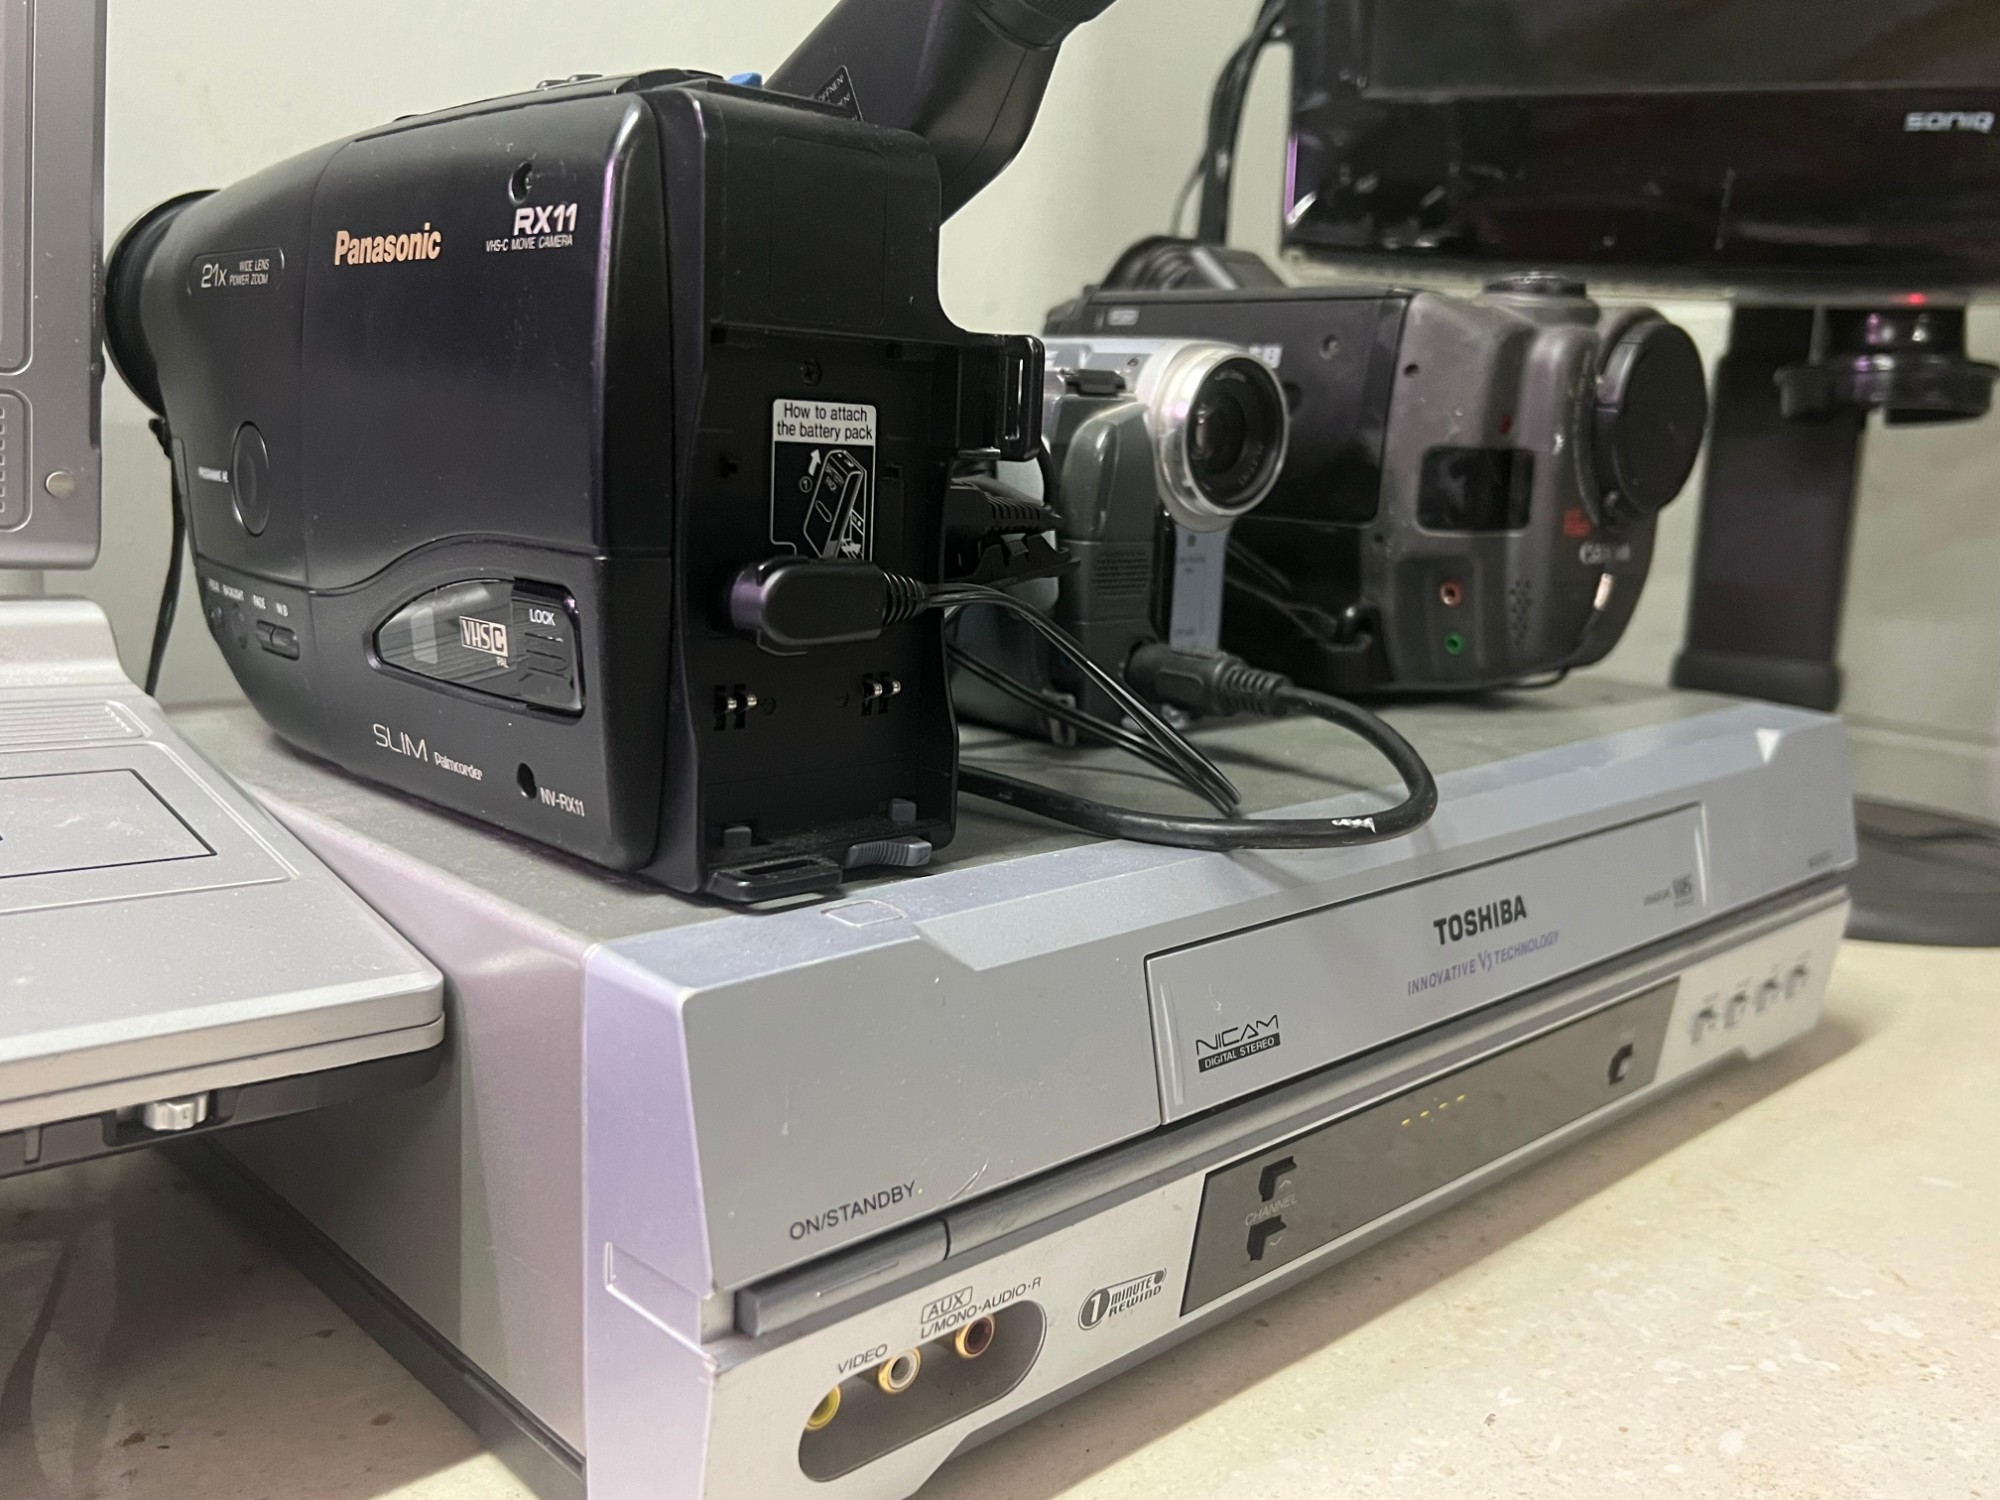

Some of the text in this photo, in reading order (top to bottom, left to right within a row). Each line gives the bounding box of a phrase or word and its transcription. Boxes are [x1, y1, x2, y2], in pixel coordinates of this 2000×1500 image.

[514, 203, 578, 236] RX11
[333, 222, 441, 266] Panasonic
[486, 233, 573, 252] VHS-C MOVIE CAMERA
[229, 273, 269, 286] POWER ZOOM
[239, 258, 270, 272] WIDE LENS
[784, 402, 867, 422] How to attach
[777, 420, 873, 441] the battery pack
[529, 608, 556, 627] LOCK
[373, 723, 483, 782] SLIM Palmcorder
[540, 786, 586, 818] NV-RX11
[1433, 894, 1528, 946] TOSHIBA
[1407, 959, 1477, 996] INNOVATIVE
[1494, 930, 1560, 965] TECHNOLOGY
[1195, 1014, 1279, 1056] NICAM
[1204, 1036, 1275, 1069] DIGITAL STEREO
[789, 1179, 916, 1240] ON/STANDBY
[1245, 1193, 1297, 1226] CHANNEL
[927, 1291, 966, 1319] AUX
[1108, 1284, 1162, 1318] REWIND
[837, 1343, 888, 1374] VIDEO
